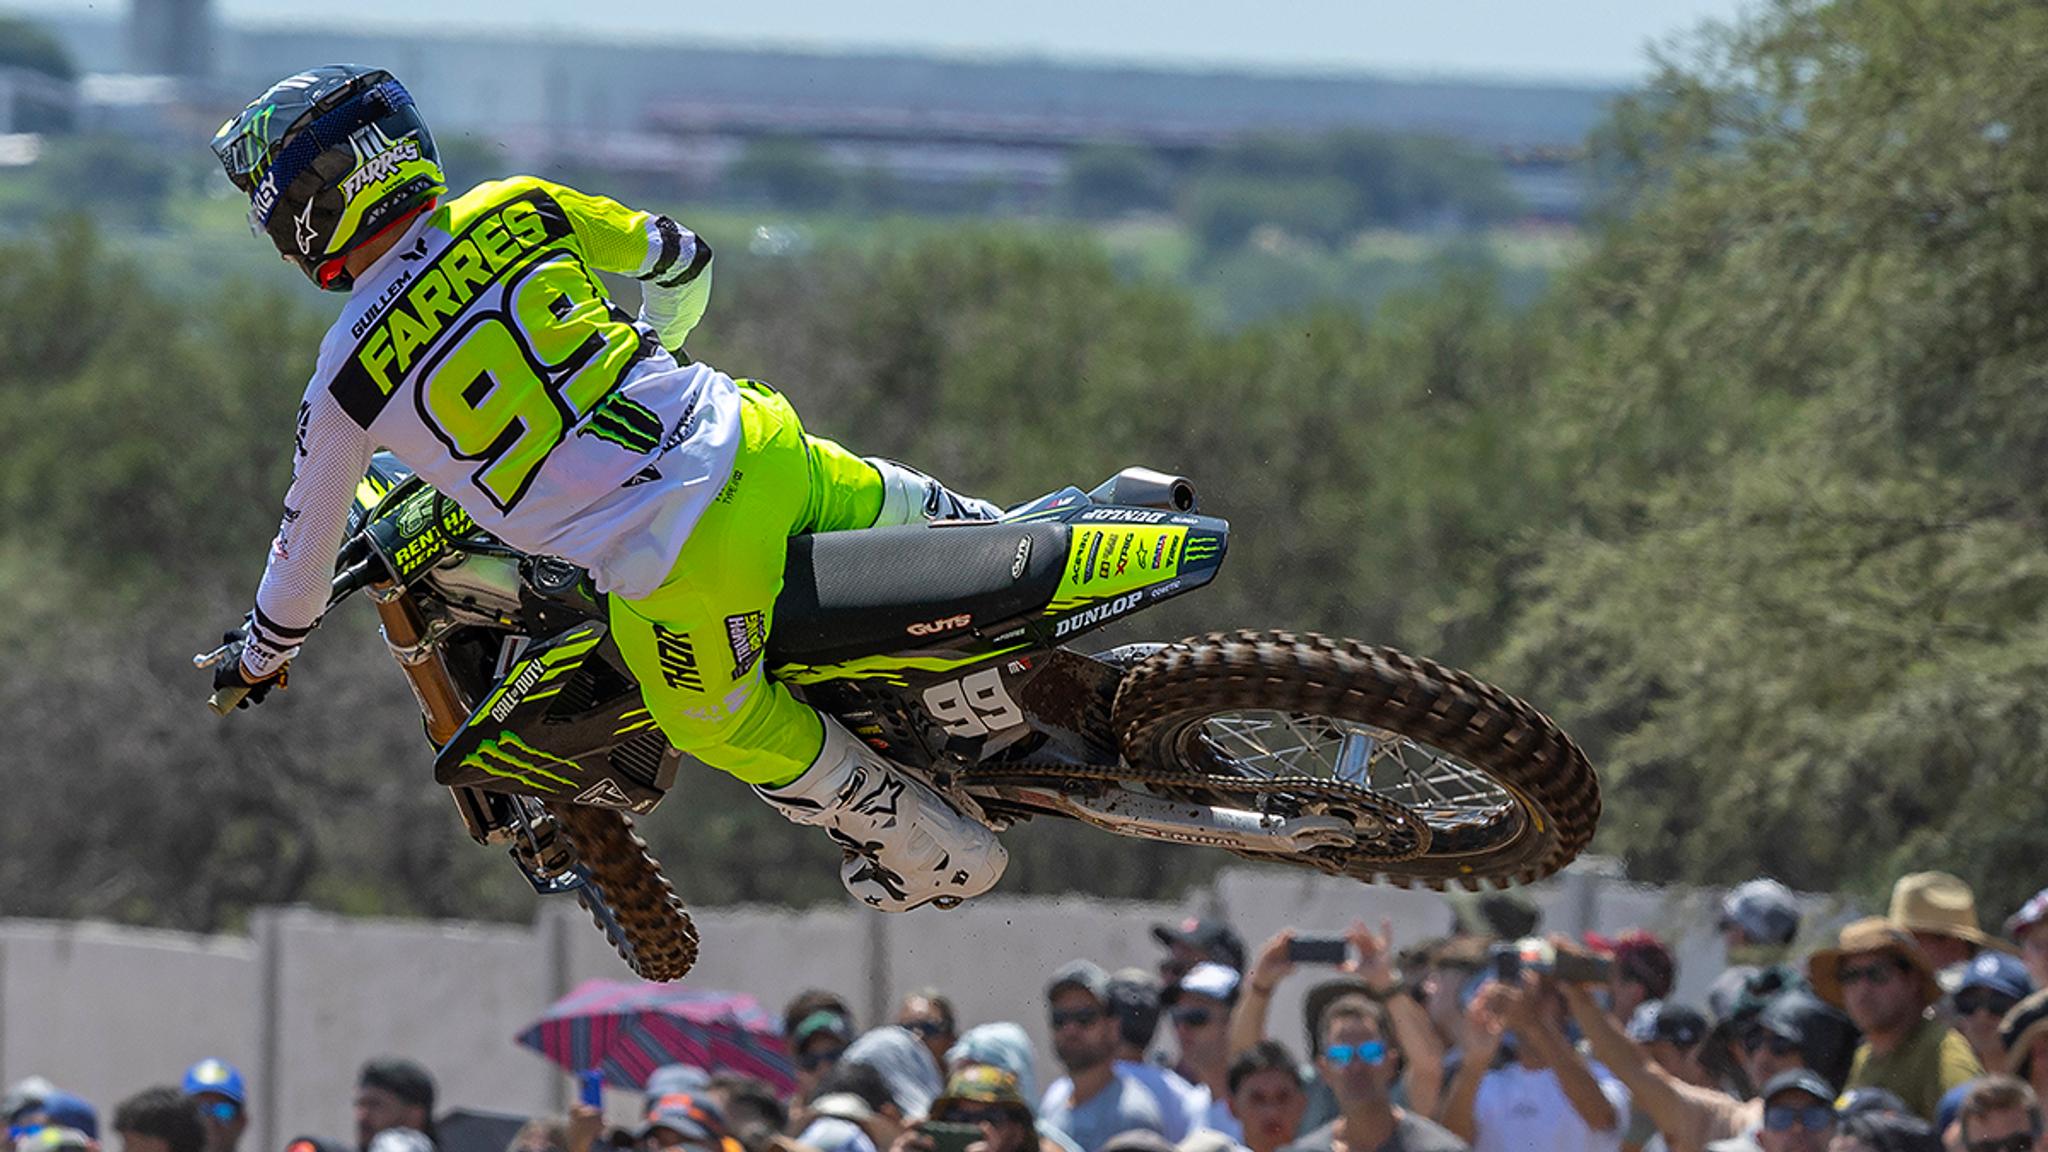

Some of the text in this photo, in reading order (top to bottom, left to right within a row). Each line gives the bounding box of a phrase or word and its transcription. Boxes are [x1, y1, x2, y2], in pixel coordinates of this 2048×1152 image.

[253, 171, 279, 220] KLEY
[351, 270, 412, 339] GUILLEM
[358, 200, 548, 396] FARRES
[414, 248, 640, 517] 99
[1082, 509, 1167, 523] DUNLOP
[906, 613, 972, 636] GUTS
[1055, 590, 1143, 637] DUNLOP
[491, 693, 519, 723] CALL
[515, 658, 544, 695] DUTY
[653, 622, 705, 693] THOR
[923, 667, 1024, 738] 99
